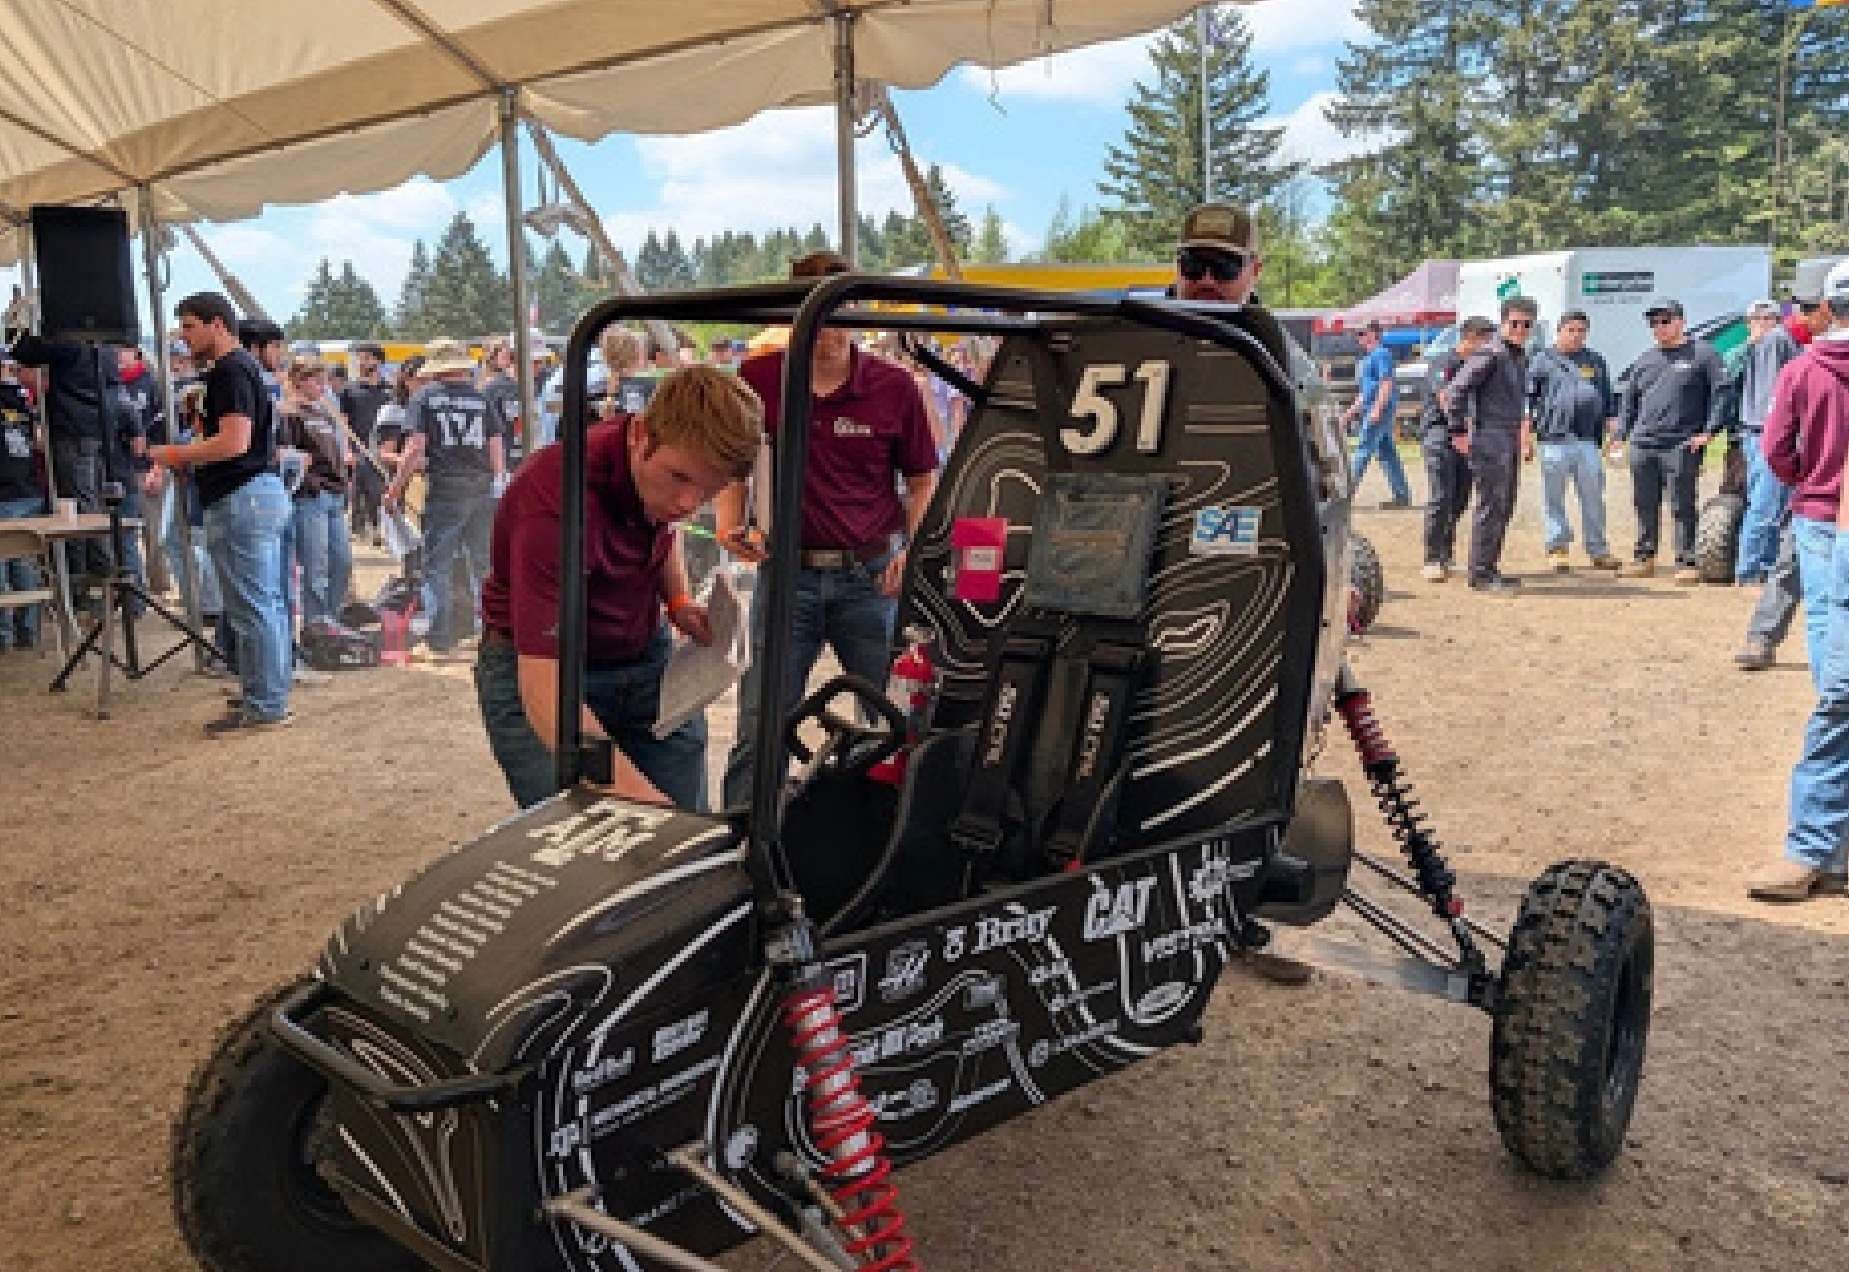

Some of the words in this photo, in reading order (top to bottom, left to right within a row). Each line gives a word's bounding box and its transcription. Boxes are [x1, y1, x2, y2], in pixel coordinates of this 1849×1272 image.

[1059, 360, 1170, 453] 51
[1197, 509, 1256, 542] SAE
[1084, 876, 1158, 940] CAT
